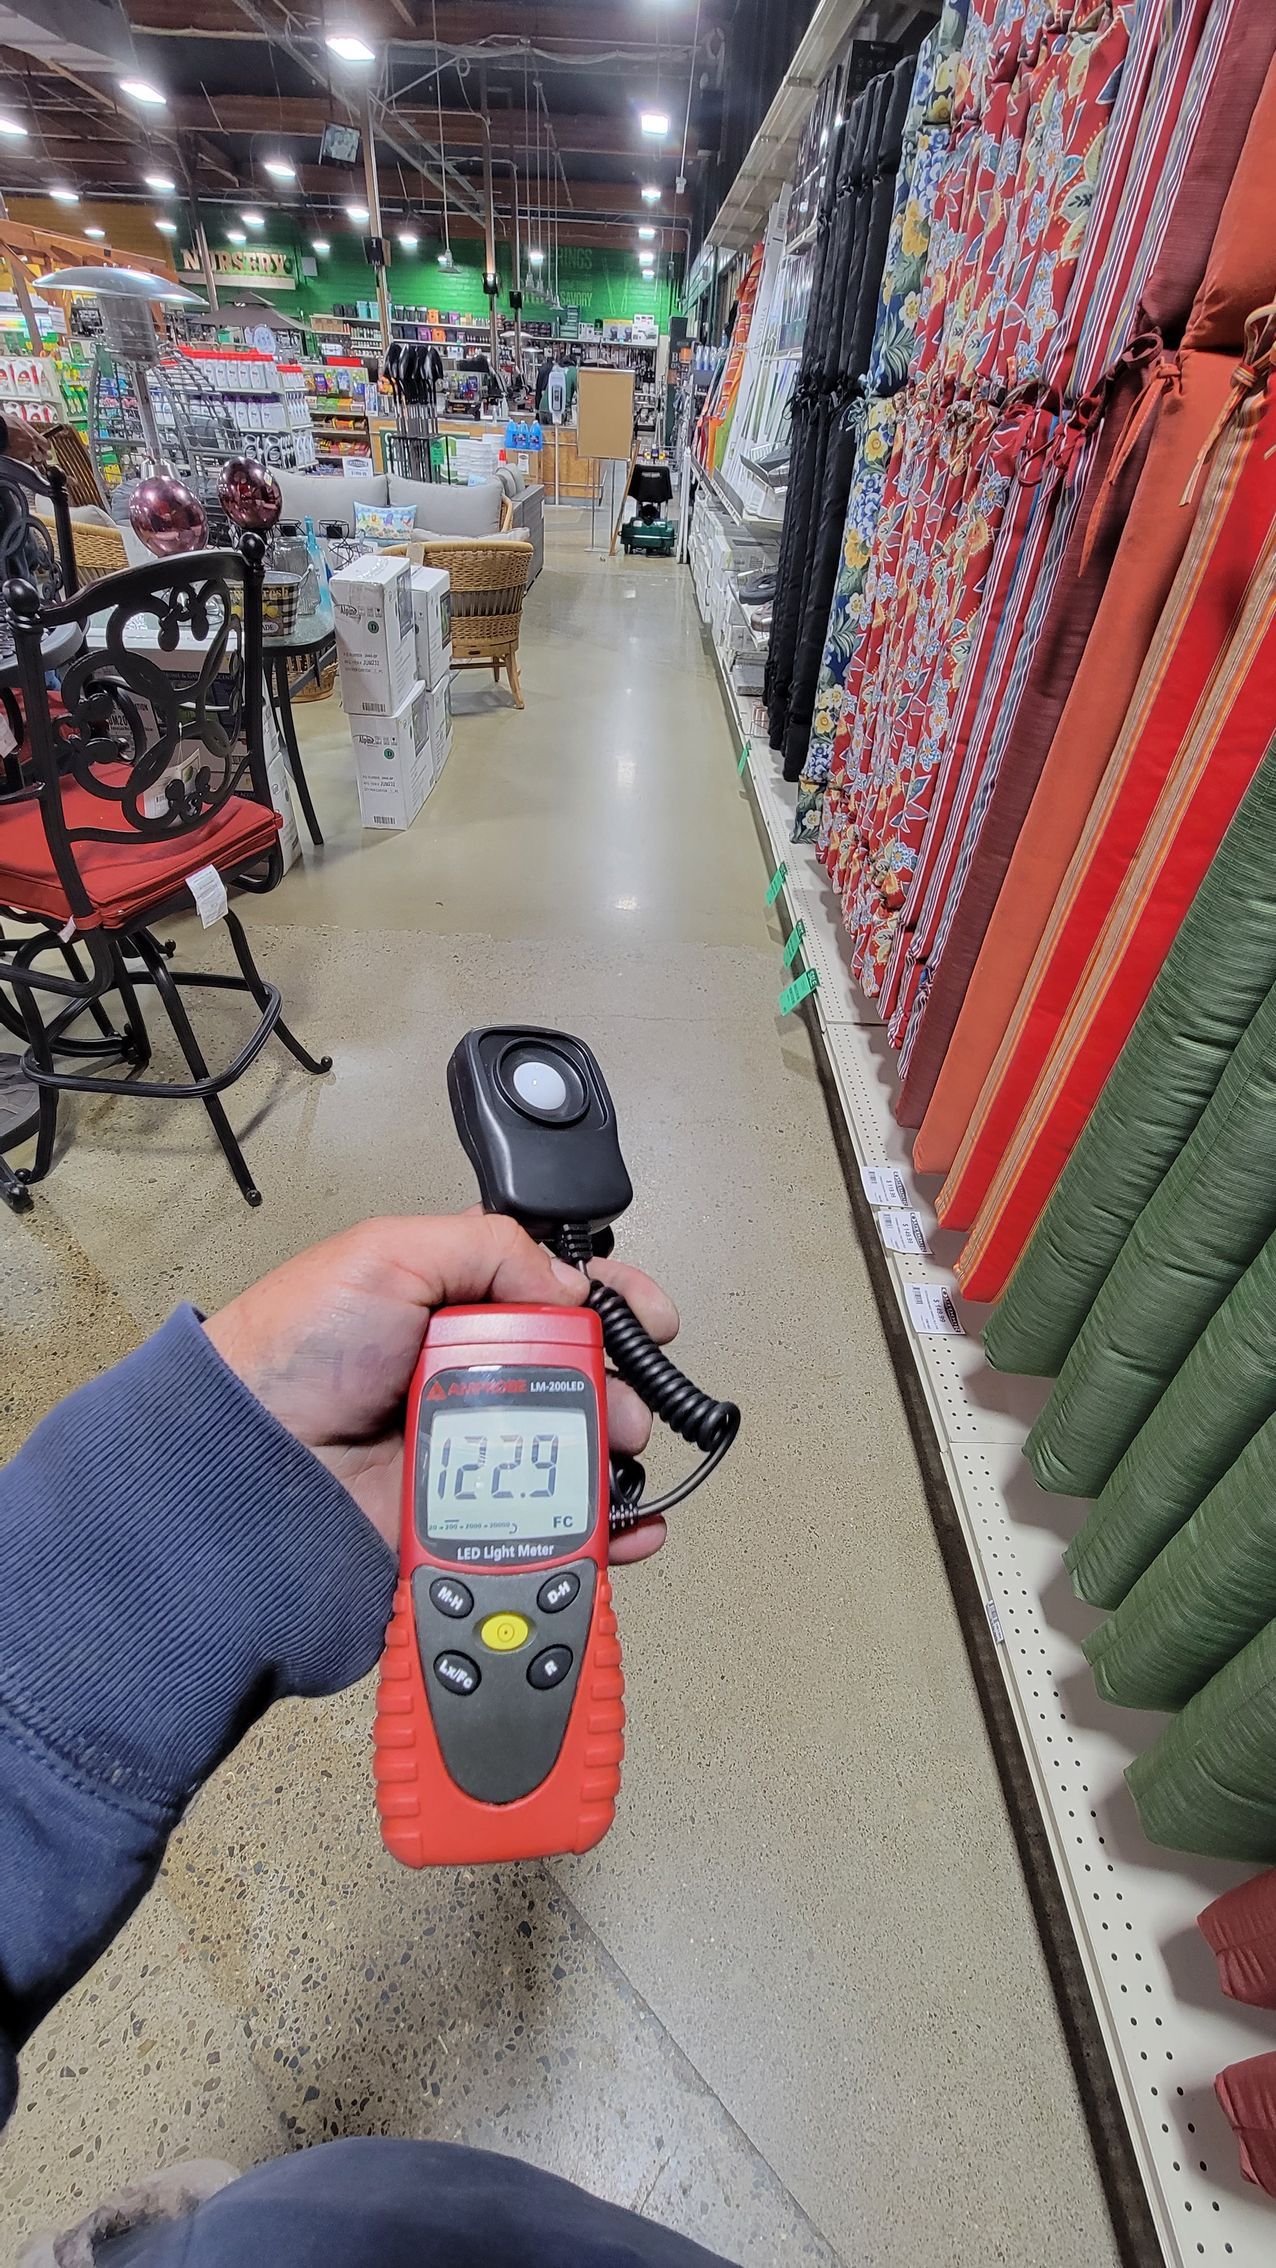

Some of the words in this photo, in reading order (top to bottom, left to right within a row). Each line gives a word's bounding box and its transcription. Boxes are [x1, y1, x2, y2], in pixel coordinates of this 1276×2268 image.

[560, 291, 593, 307] SAVORY
[530, 1381, 585, 1393] LM-200LED
[437, 1433, 559, 1500] 122.9
[552, 1515, 573, 1528] FC
[457, 1547, 480, 1561] LED
[484, 1545, 515, 1562] Light
[518, 1544, 554, 1558] Meter
[547, 1581, 571, 1604] D-H
[545, 1663, 558, 1676] R
